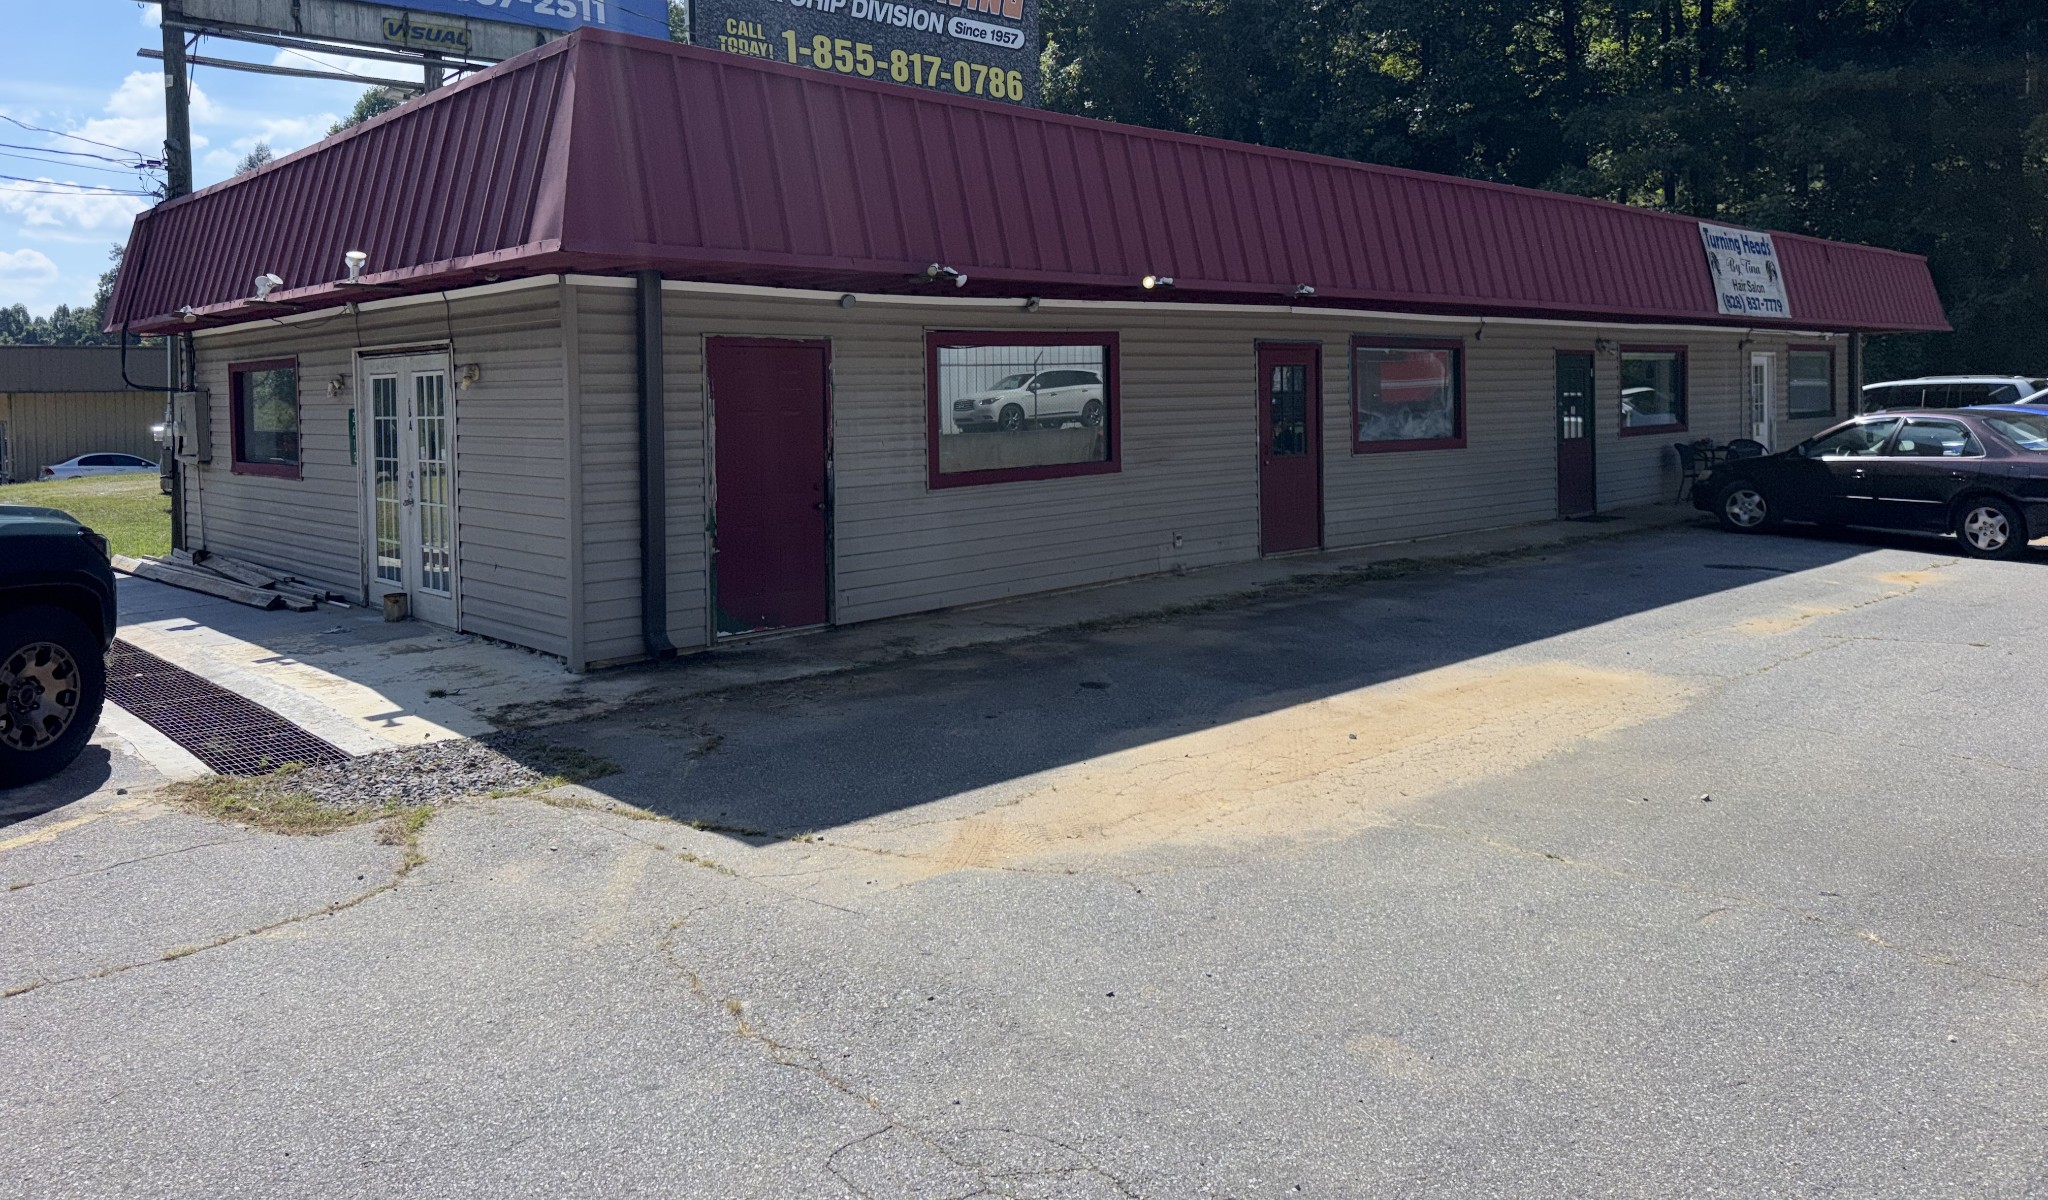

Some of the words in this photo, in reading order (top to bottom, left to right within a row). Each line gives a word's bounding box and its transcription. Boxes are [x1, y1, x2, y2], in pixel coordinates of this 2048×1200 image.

[388, 22, 469, 46] VSUAL
[726, 18, 766, 40] CALL
[851, 0, 945, 34] DIVISION
[954, 21, 988, 39] Since
[990, 29, 1019, 45] 1957
[718, 35, 774, 60] TODAY!
[781, 29, 1023, 101] 1-855-817-0786
[1703, 227, 1742, 256] Turning
[1740, 233, 1771, 256] Heads
[1726, 256, 1742, 276] By
[1740, 258, 1761, 275] Tina
[1732, 279, 1746, 292] Hair
[1747, 280, 1766, 294] Salon
[1722, 292, 1746, 313] (828)
